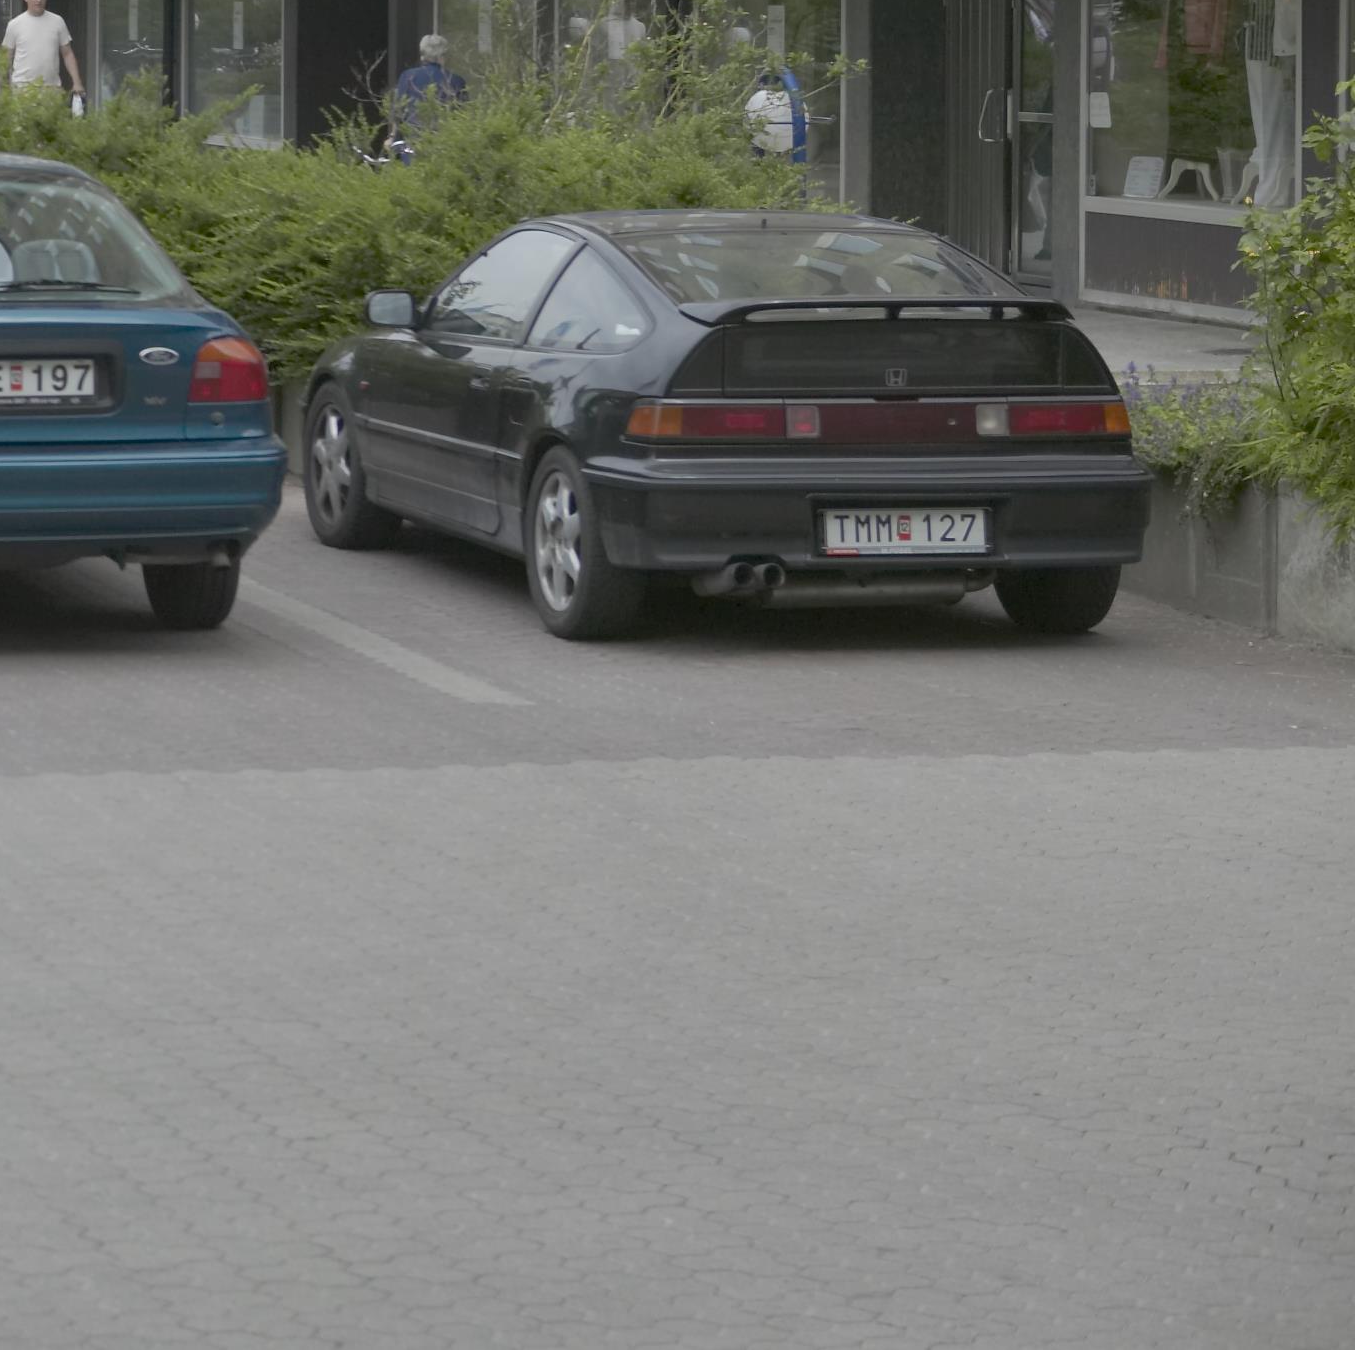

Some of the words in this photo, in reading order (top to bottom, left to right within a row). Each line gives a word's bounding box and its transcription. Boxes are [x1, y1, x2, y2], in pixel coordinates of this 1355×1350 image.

[32, 364, 91, 391] 197
[833, 514, 893, 543] TMM
[922, 513, 976, 542] 127
